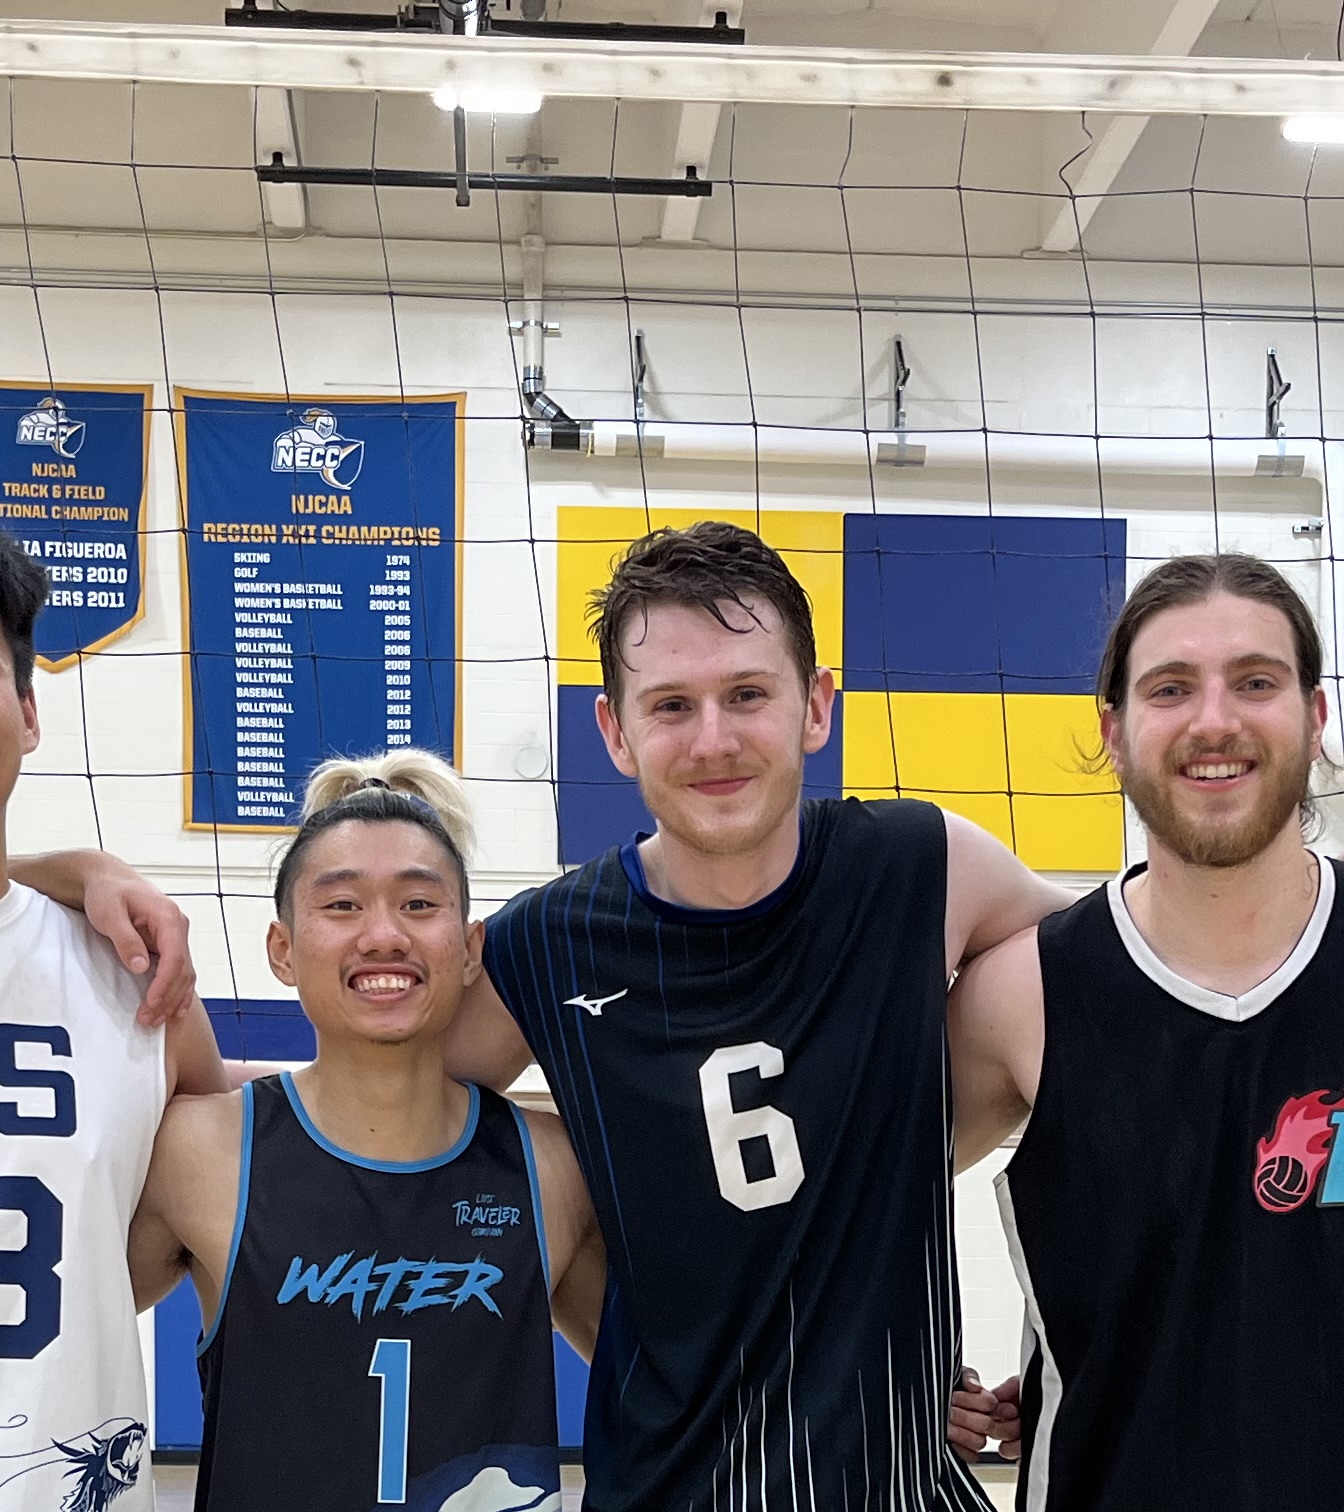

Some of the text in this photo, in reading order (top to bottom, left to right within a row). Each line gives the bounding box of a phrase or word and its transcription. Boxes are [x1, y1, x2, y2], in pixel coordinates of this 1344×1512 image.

[20, 425, 68, 442] NECC
[276, 446, 341, 468] NECC
[32, 463, 76, 478] NJCAA
[3, 483, 105, 500] TRACK & FIELD
[291, 495, 352, 514] NJCAA
[51, 505, 129, 522] CHAMPION
[203, 523, 441, 546] REGION XXI CHAMPIONS
[45, 541, 127, 560] FIGUEROA
[234, 553, 410, 566] SKIING 1974
[86, 567, 128, 584] 2010
[234, 568, 410, 581] GOLF 1993
[234, 583, 282, 594] WOMEN'S
[86, 591, 126, 608] 2011
[234, 598, 282, 609] WOMEN'S
[234, 612, 293, 624] VOLLEYBALL
[235, 628, 283, 638] BASEBALL
[235, 643, 293, 654] VOLLEYBALL
[235, 658, 294, 669] VOLLEYBALL
[236, 672, 294, 684] VOLLEYBALL
[236, 687, 284, 699] BASEBALL
[236, 702, 294, 714] VOLLEYBALL
[237, 717, 284, 728] BASEBALL
[237, 732, 285, 743] BASEBALL
[237, 747, 285, 758] BASEBALL
[237, 762, 285, 773] BASEBALL
[237, 777, 285, 788] BASEBALL
[237, 791, 295, 803] VOLLEYBALL
[237, 806, 285, 817] BASEBALL
[698, 1041, 805, 1212] 6
[452, 1200, 521, 1227] TRAVELER
[277, 1250, 504, 1323] WATER
[368, 1338, 411, 1504] 1
